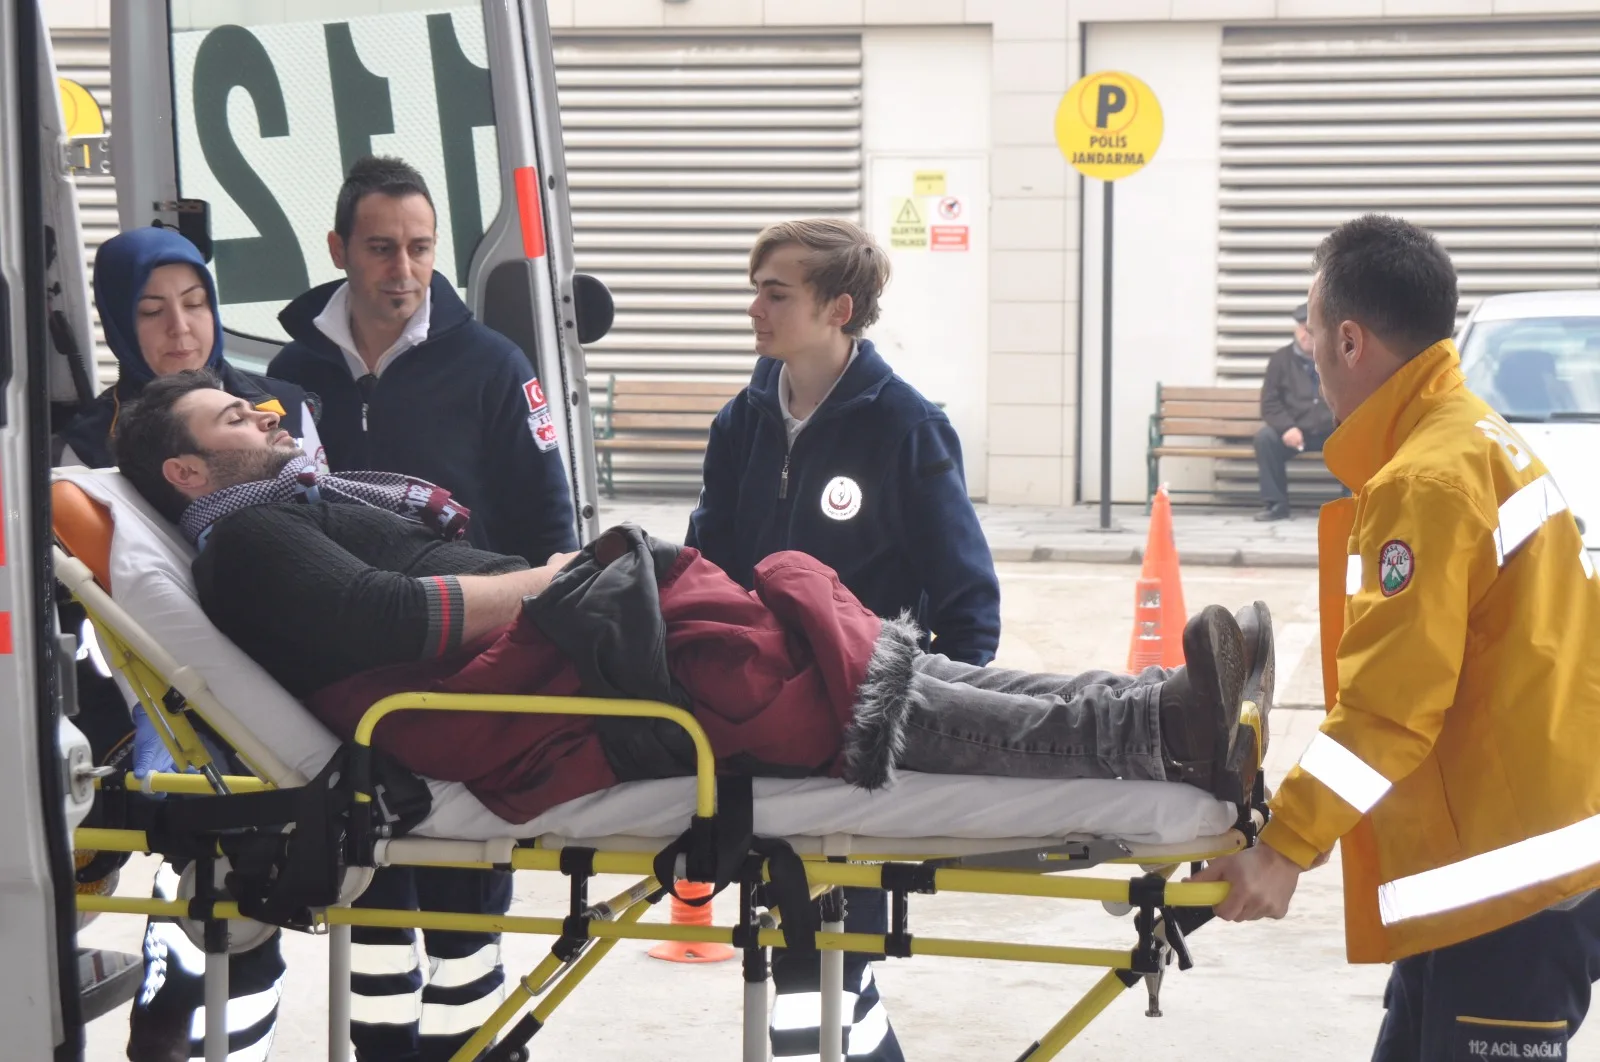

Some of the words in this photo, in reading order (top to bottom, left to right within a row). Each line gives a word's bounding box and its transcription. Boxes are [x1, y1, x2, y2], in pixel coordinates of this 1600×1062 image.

[1096, 84, 1126, 128] P
[1072, 152, 1145, 165] JANDARMA
[1468, 1039, 1488, 1055] 112
[1490, 1041, 1521, 1057] ACİL
[1523, 1041, 1562, 1058] SAĞLIK
